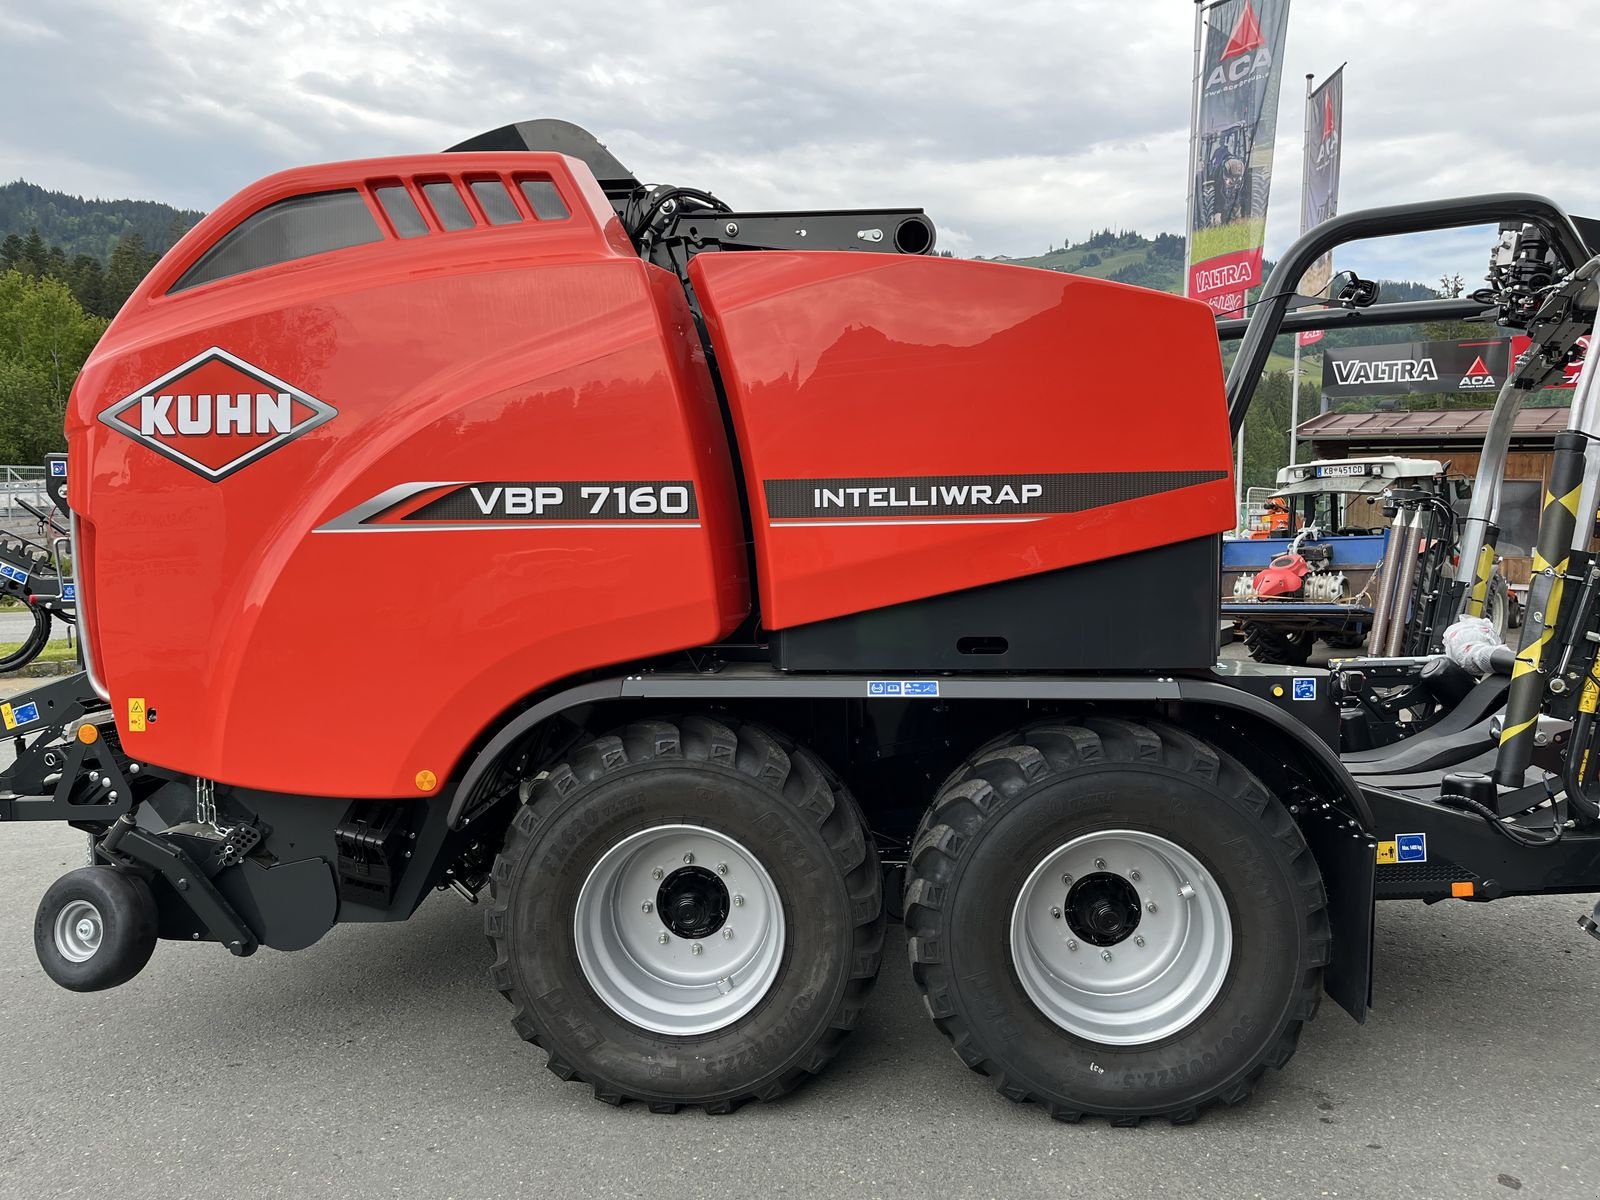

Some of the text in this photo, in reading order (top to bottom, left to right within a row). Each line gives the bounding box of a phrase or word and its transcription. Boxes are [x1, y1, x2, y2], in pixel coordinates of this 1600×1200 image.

[1205, 48, 1272, 90] ACA
[1196, 262, 1252, 293] VALTRA
[1332, 358, 1438, 385] VALTRA
[1459, 375, 1495, 385] ACA
[140, 393, 291, 436] KUHN
[469, 486, 690, 515] VBP 7160
[814, 484, 1043, 508] INTELLIWRAP
